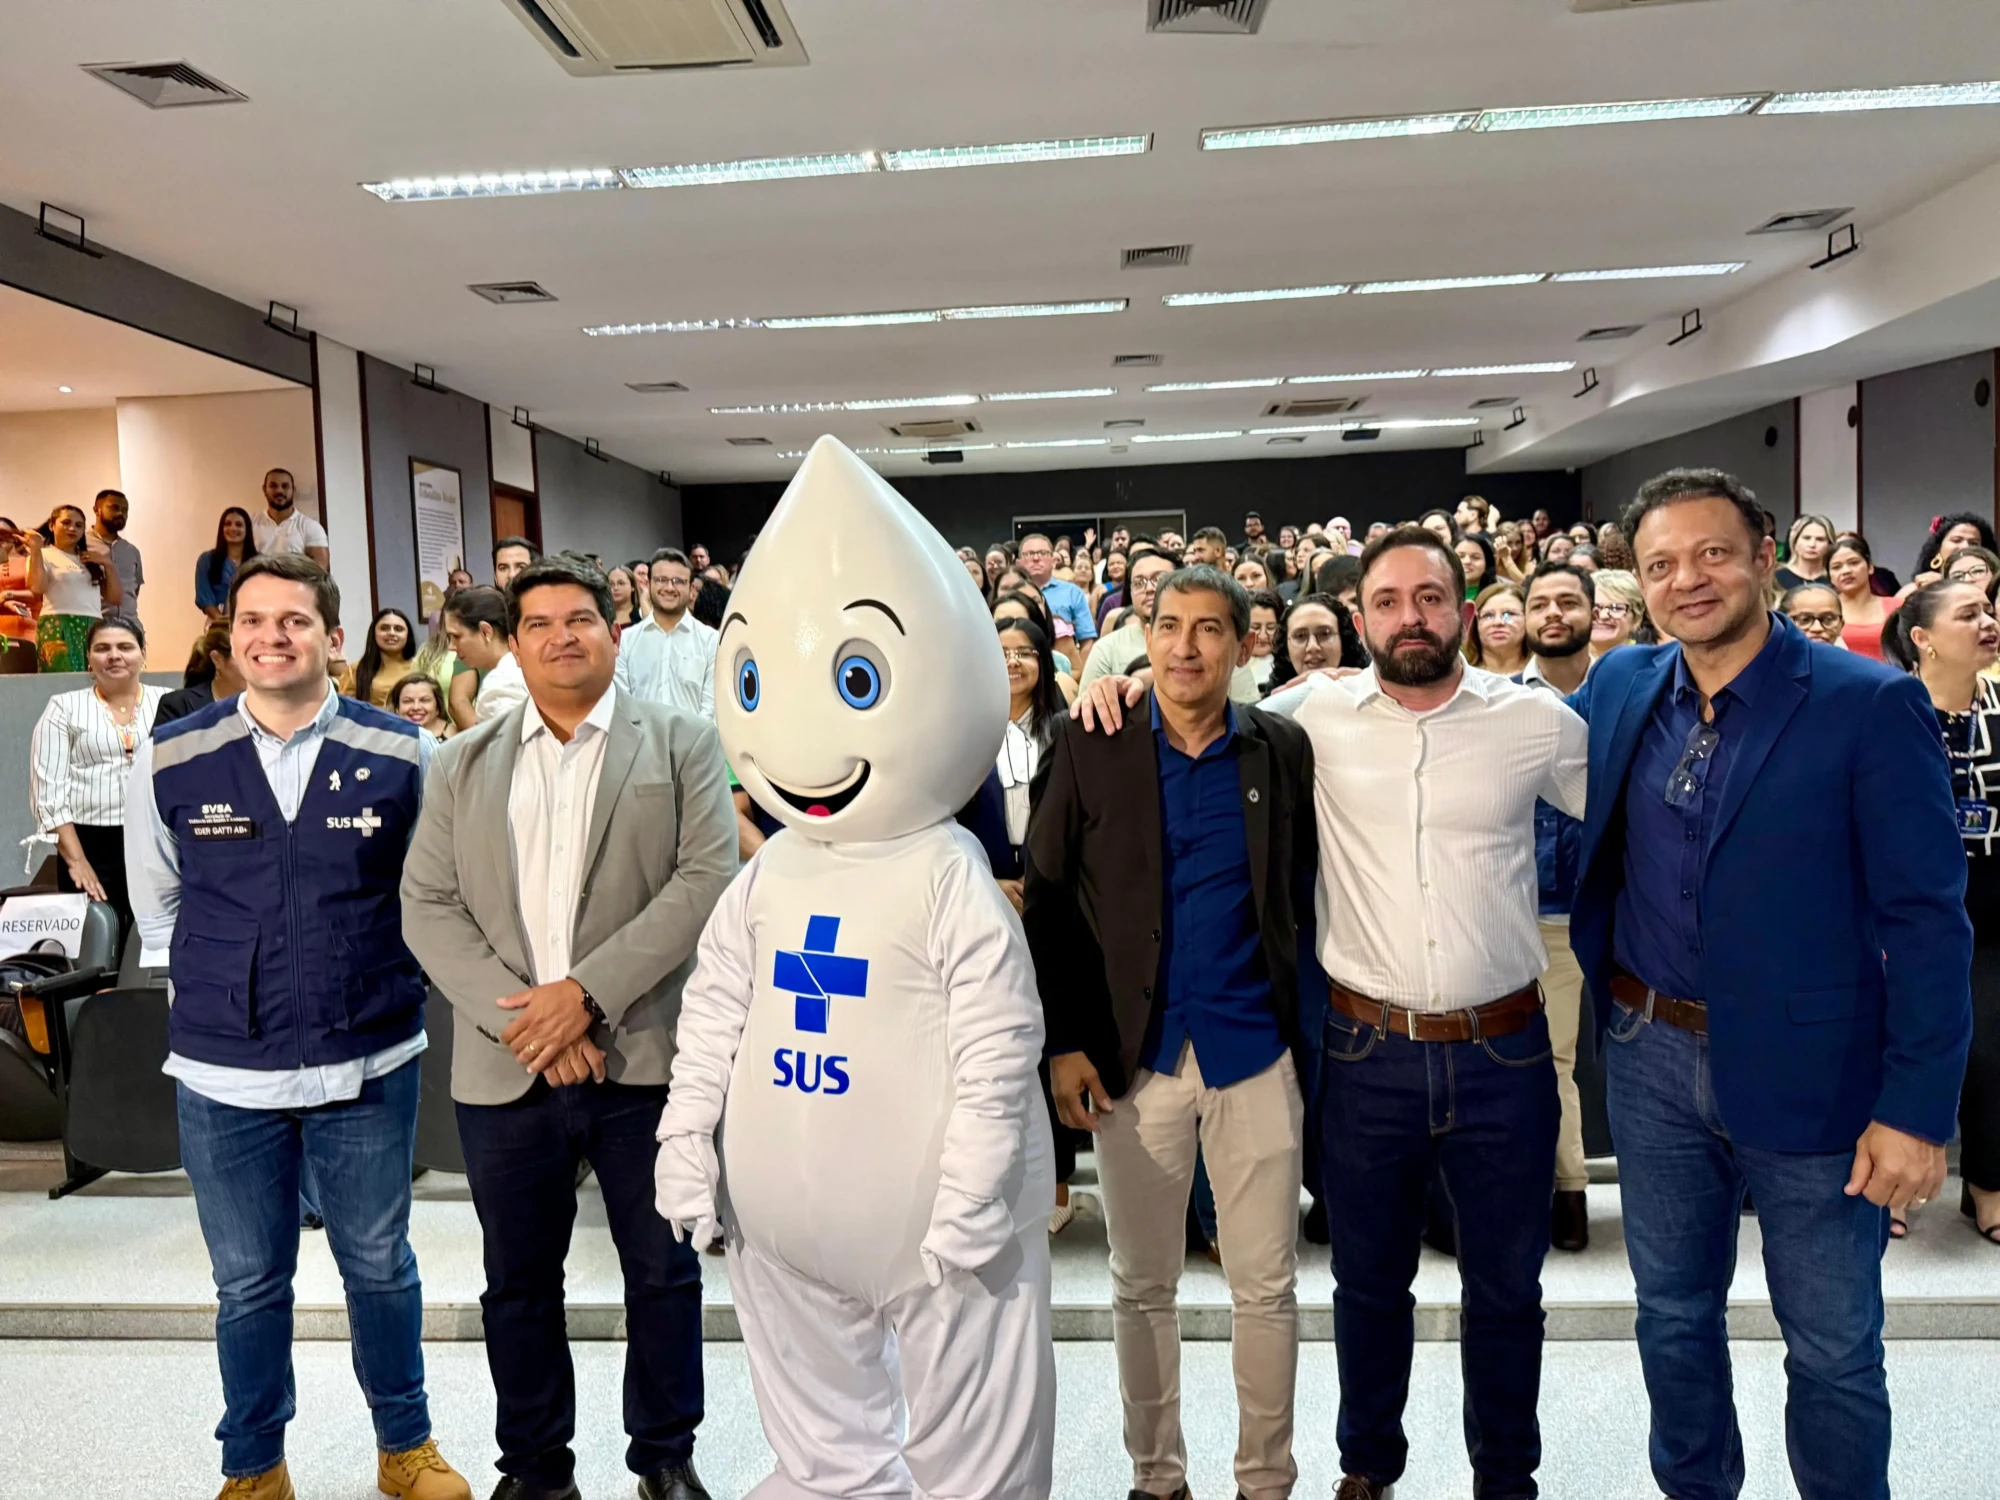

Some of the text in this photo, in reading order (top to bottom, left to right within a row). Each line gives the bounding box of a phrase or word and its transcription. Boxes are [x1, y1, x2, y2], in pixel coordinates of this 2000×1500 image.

[201, 803, 233, 814] SVSA
[326, 816, 351, 829] SUS
[194, 825, 248, 836] EDER GATTI AB+
[1, 918, 80, 934] RESERVADO
[773, 1047, 850, 1095] SUS
